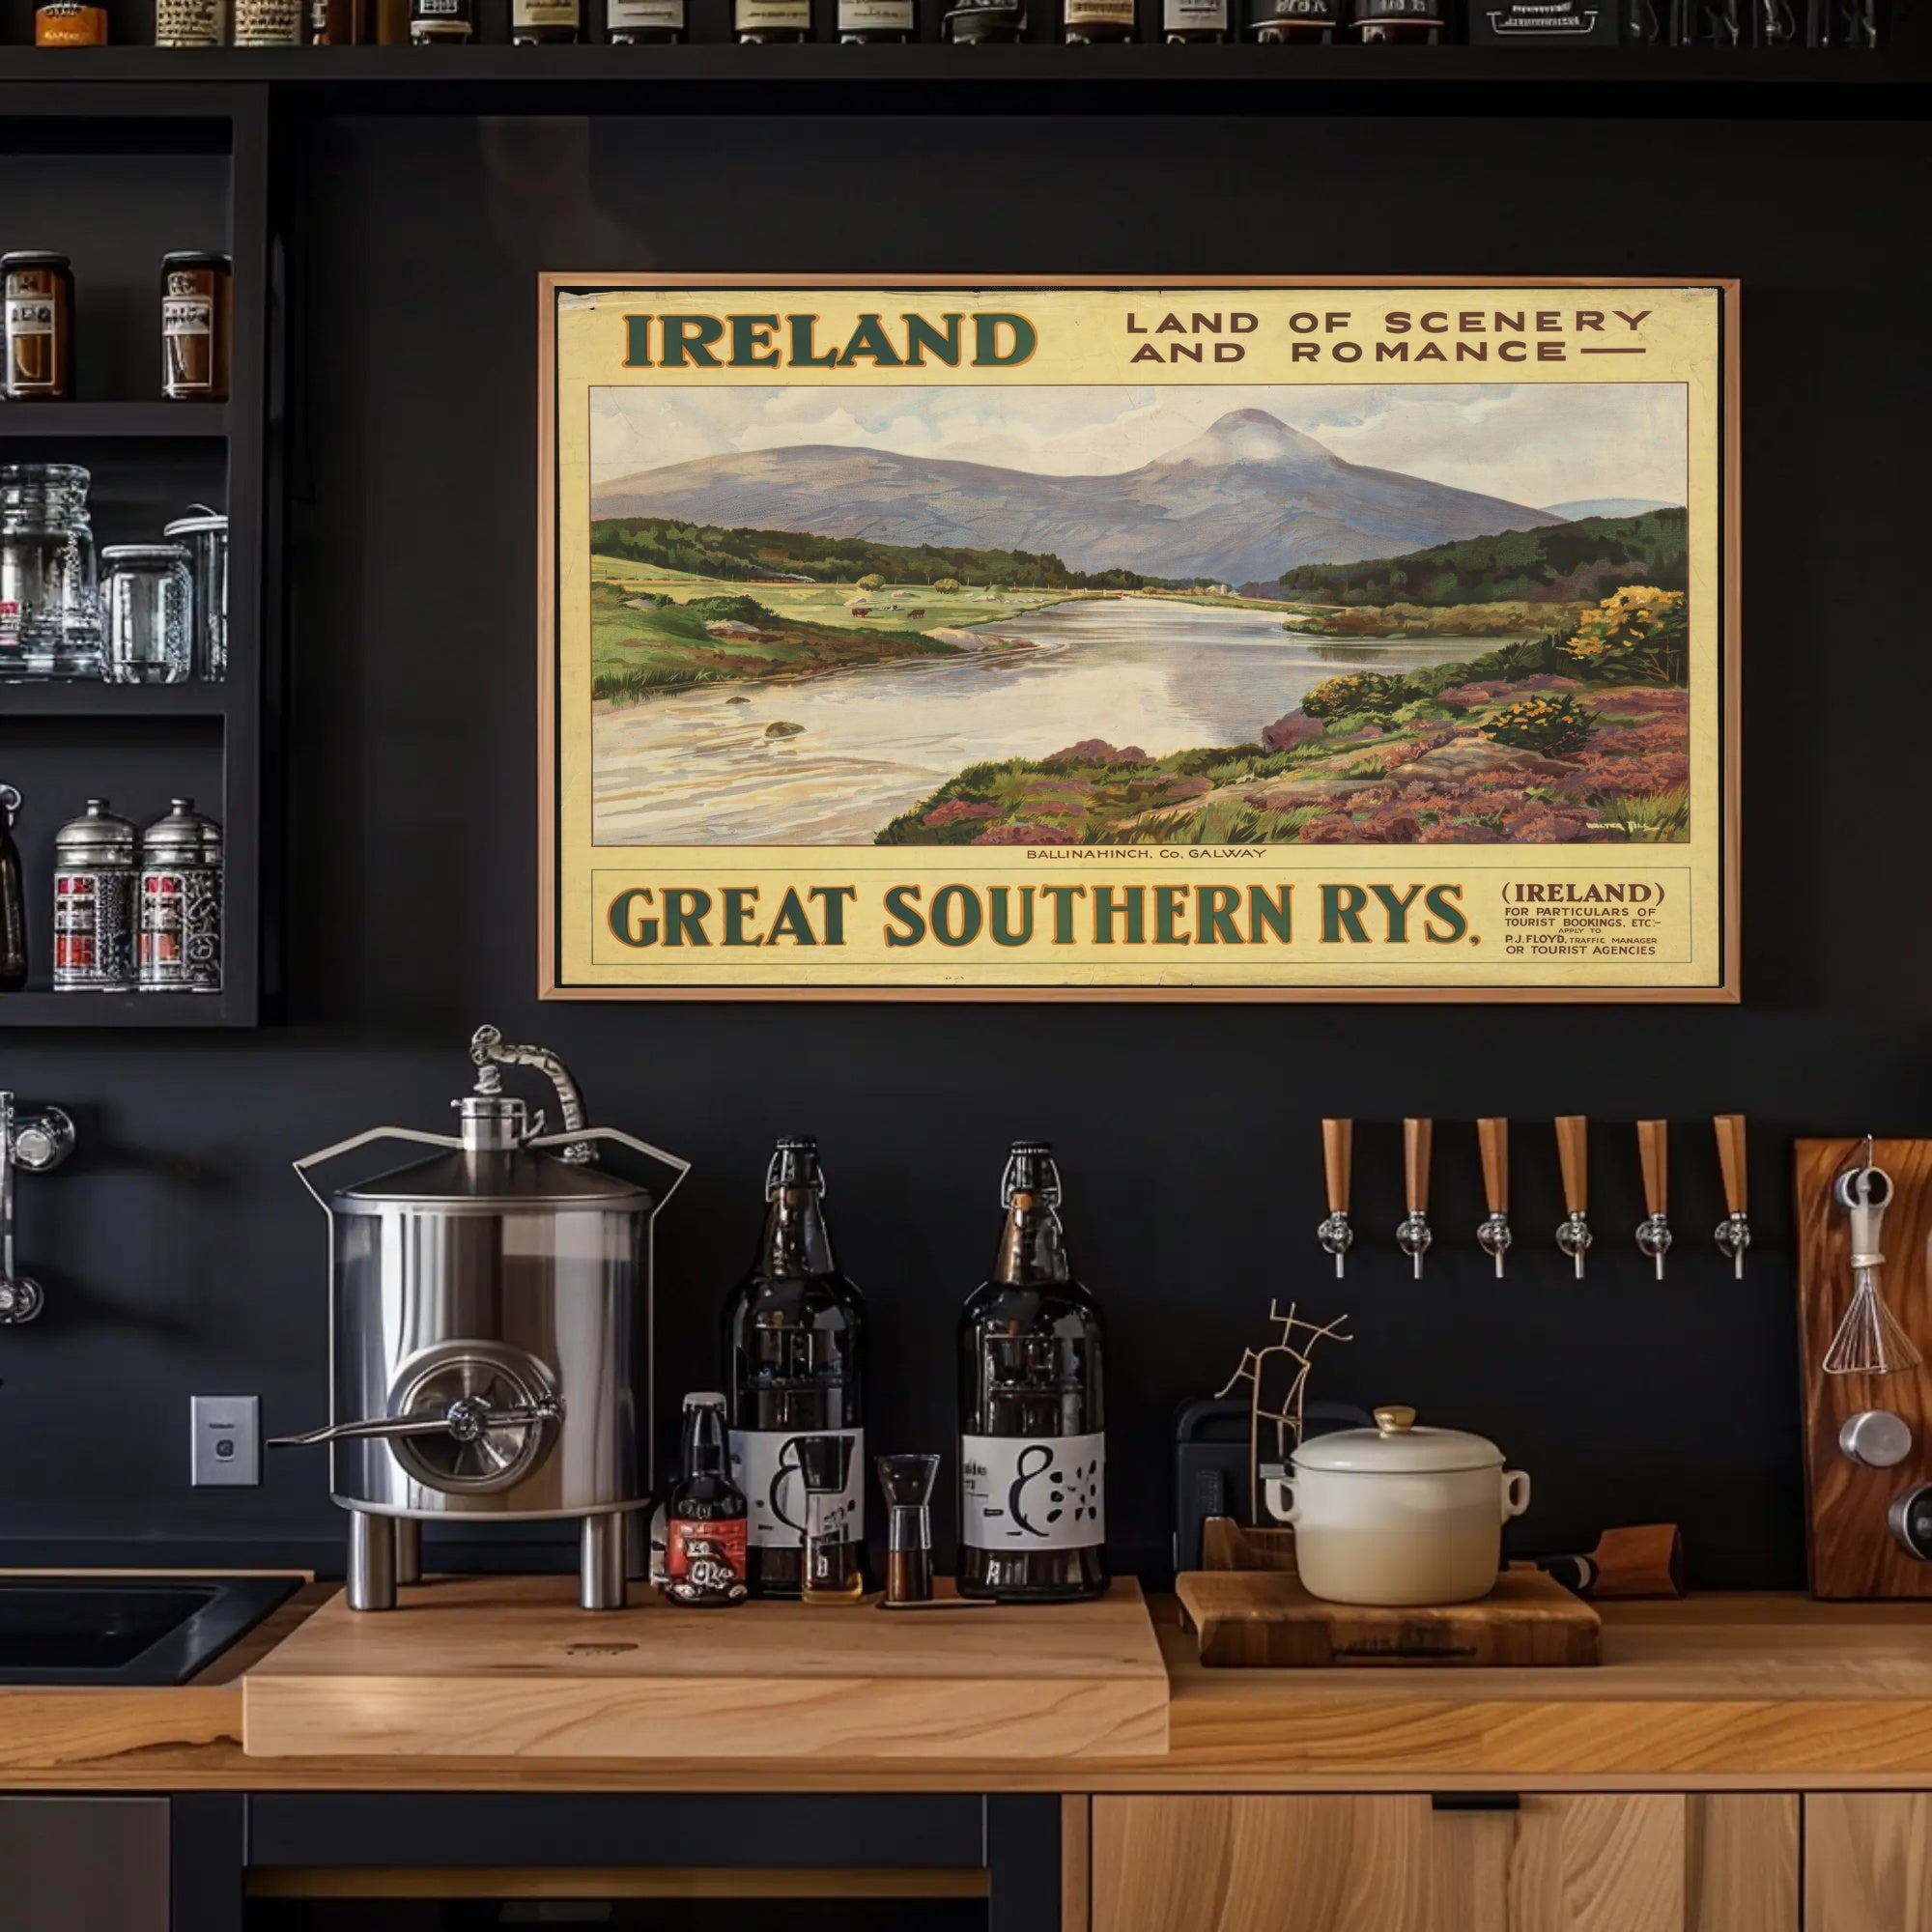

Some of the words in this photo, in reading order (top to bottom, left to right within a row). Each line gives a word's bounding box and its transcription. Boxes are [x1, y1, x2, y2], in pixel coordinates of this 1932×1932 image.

[1127, 313, 1259, 333] LAND
[1289, 312, 1350, 333] OF
[1385, 310, 1653, 334] SCENERY
[621, 312, 1037, 370] IRELAND
[1129, 343, 1245, 363] AND
[1027, 849, 1153, 860] BALLINAHINCH.
[1188, 848, 1267, 859] GALWAY
[1502, 882, 1664, 906] (IRELAND)
[607, 885, 857, 948] GREAT
[883, 884, 1294, 948] SOUTHERN
[1504, 906, 1529, 917] FOR
[1536, 906, 1630, 917] PARTICULARS
[1636, 907, 1657, 918] OF
[1504, 918, 1556, 927] TOURIST
[1505, 945, 1525, 954] OR
[1530, 945, 1588, 955] TOURIST
[1591, 945, 1657, 956] AGENCIES
